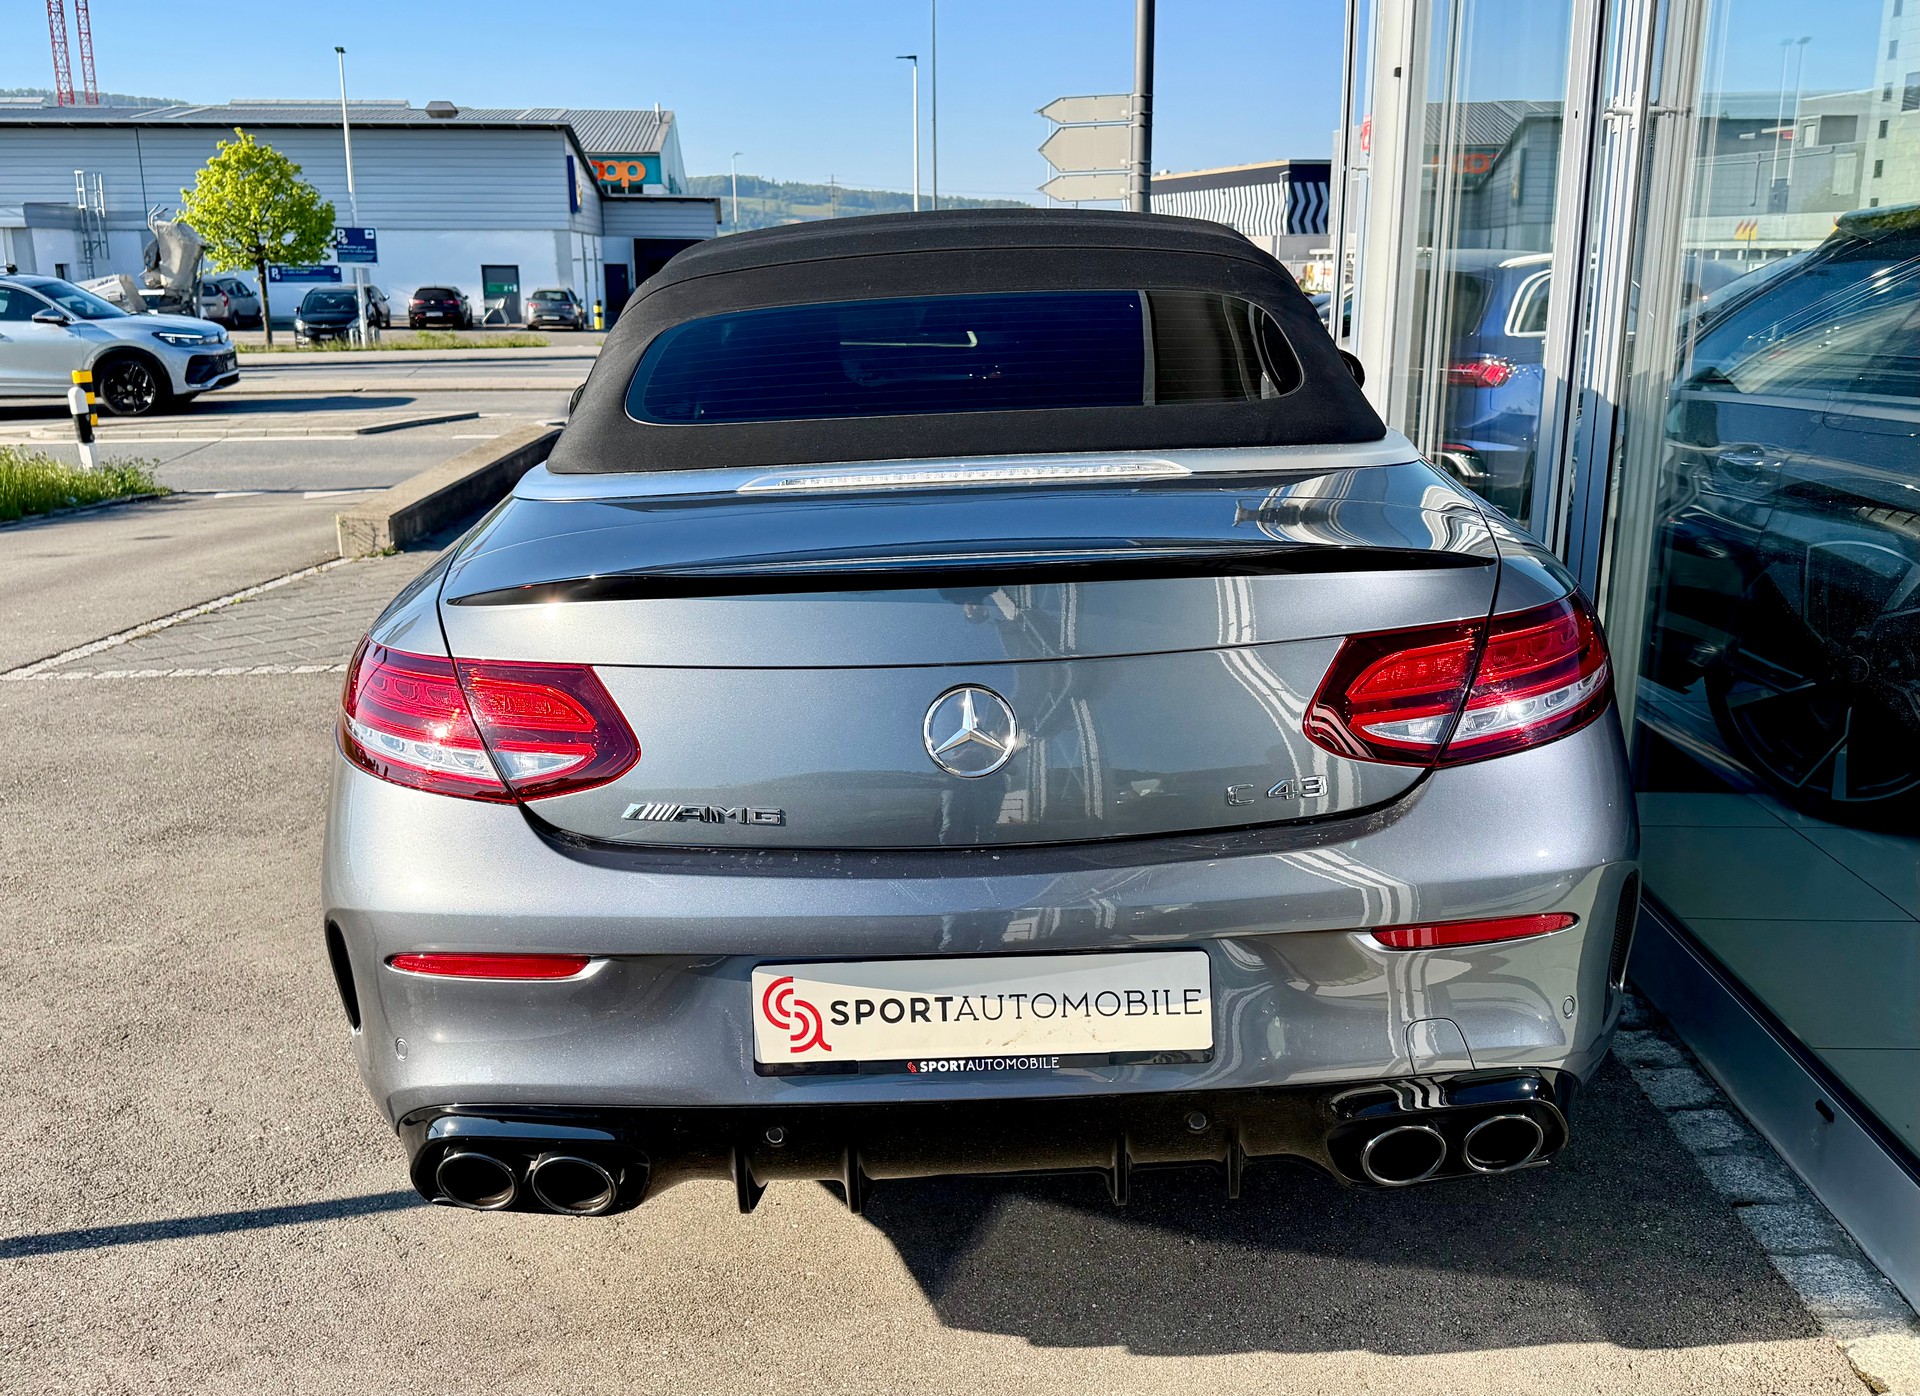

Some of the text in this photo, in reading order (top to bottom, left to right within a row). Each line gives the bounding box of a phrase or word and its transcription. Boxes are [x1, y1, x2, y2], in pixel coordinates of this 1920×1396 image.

[1226, 775, 1328, 805] C 43
[669, 803, 783, 825] AMG
[830, 988, 1203, 1026] SPORTAUTOMOBILE
[919, 1056, 1060, 1073] SPORTAUTOMOBILE
